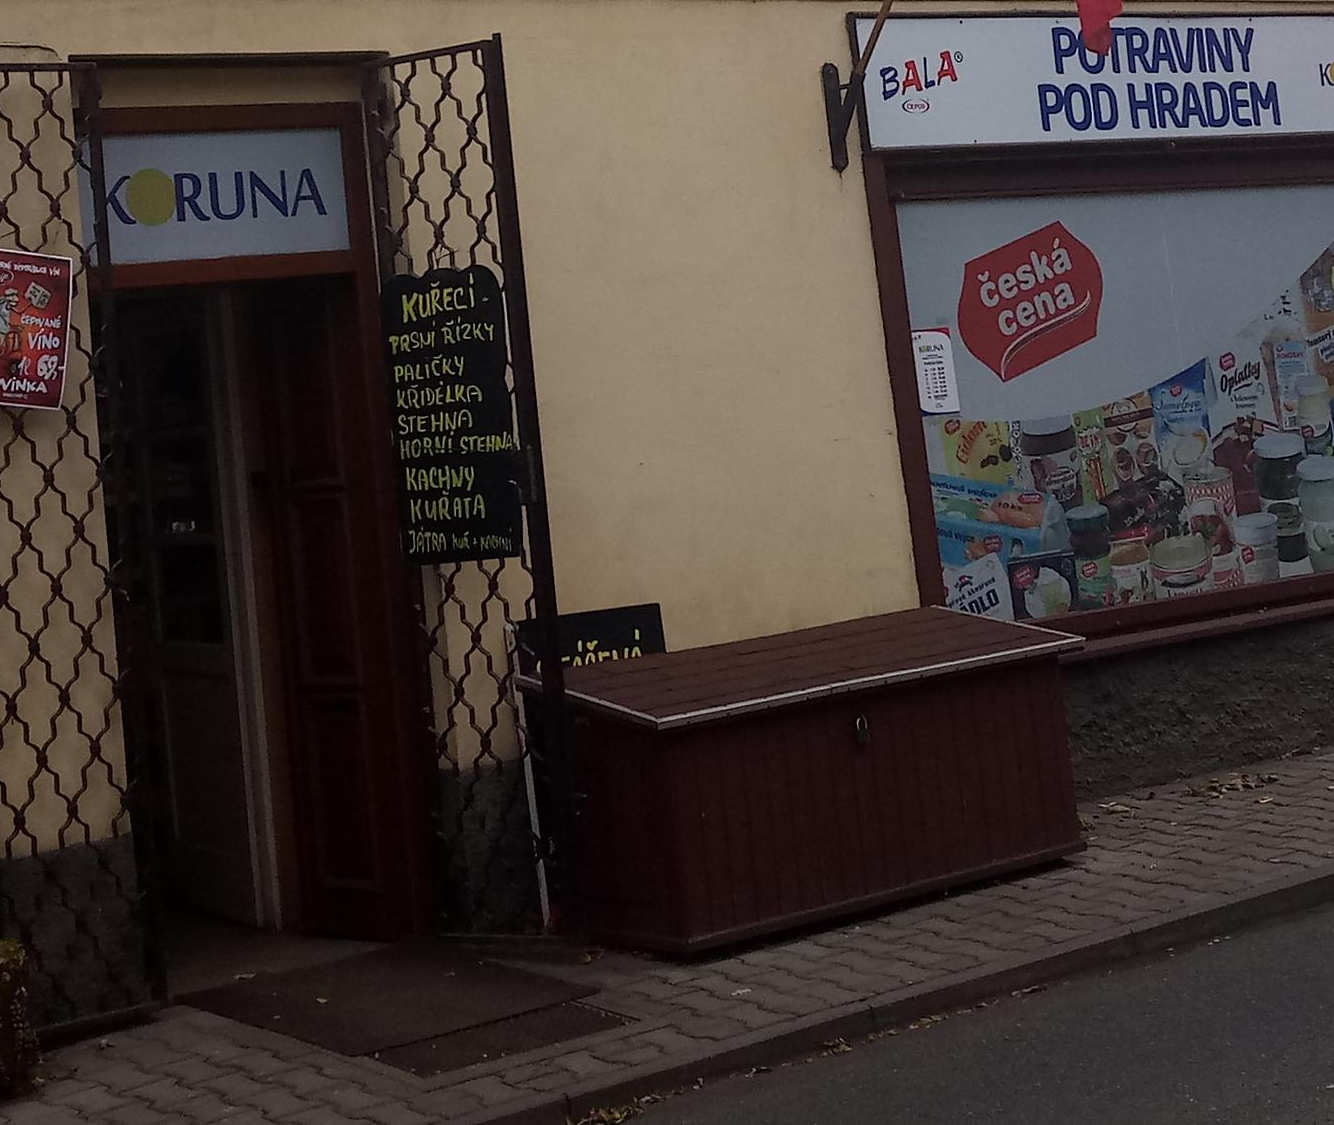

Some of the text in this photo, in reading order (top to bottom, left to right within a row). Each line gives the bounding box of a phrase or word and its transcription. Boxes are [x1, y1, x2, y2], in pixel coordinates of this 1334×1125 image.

[1052, 27, 1254, 74] POTRAVINY
[1038, 81, 1282, 131] POD HRADEM
[106, 168, 328, 226] KORUNA
[977, 238, 1072, 307] česká
[401, 272, 476, 323] KUŘECÍ
[998, 283, 1075, 335] cena
[28, 329, 60, 350] VÍNO
[389, 316, 495, 355] PRSNÍ ŘÍZKY
[394, 355, 464, 383] PALIČKY
[1220, 361, 1261, 395] Oplatky
[398, 408, 474, 435] STEHNA
[460, 431, 515, 457] STEHNA
[406, 465, 475, 492] KACHNY
[410, 490, 486, 523] KUŘATA
[408, 526, 447, 555] JÁTRA
